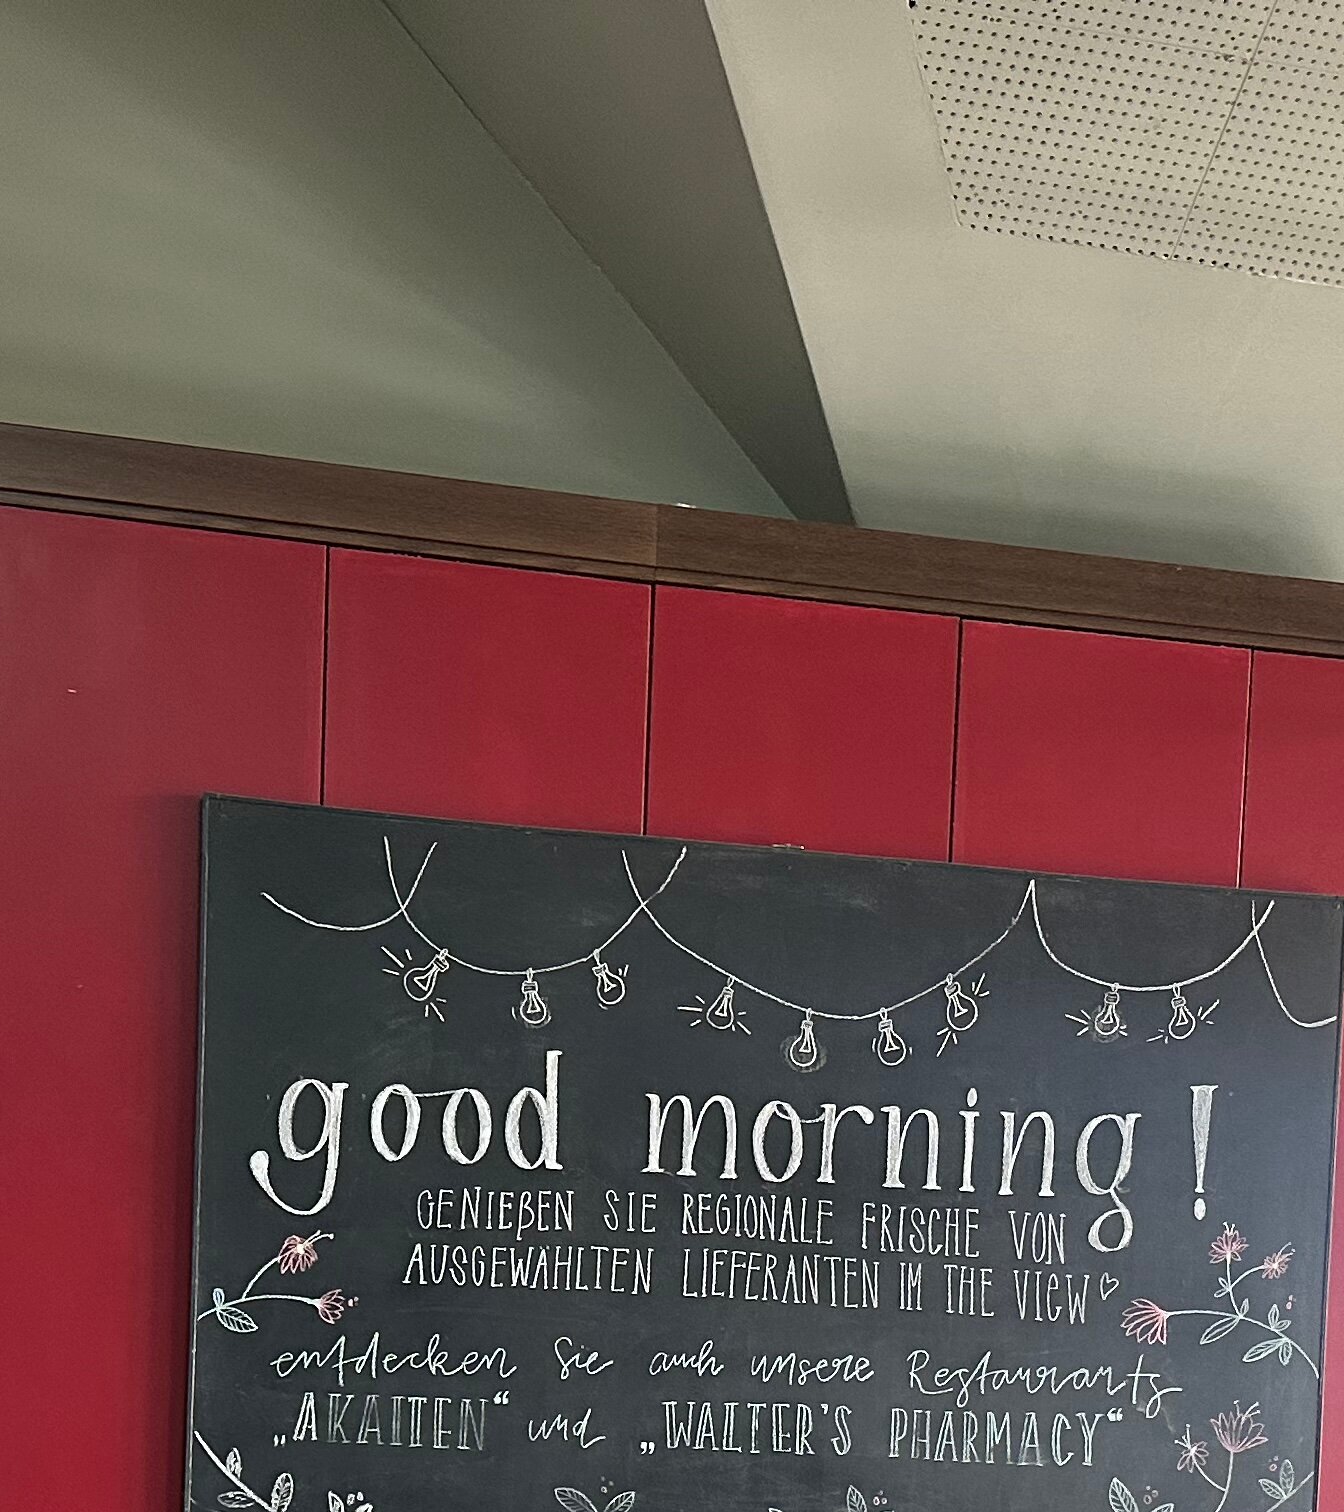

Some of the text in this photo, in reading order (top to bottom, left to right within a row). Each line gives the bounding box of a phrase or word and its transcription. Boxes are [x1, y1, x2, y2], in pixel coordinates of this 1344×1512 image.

[249, 1049, 564, 1216] good
[640, 1086, 1142, 1253] morning
[416, 1186, 1067, 1265] GENIEßEN SIE REGIONALE FRISCHE VON
[401, 1242, 654, 1295] AUSGEWÄHLTEN
[681, 1248, 881, 1309] LIEFERANTEN
[898, 1261, 923, 1311] IM
[943, 1263, 995, 1317] THE
[269, 1331, 1183, 1419] entdecken Sie auch unsere Restaurants
[528, 1407, 607, 1449] und
